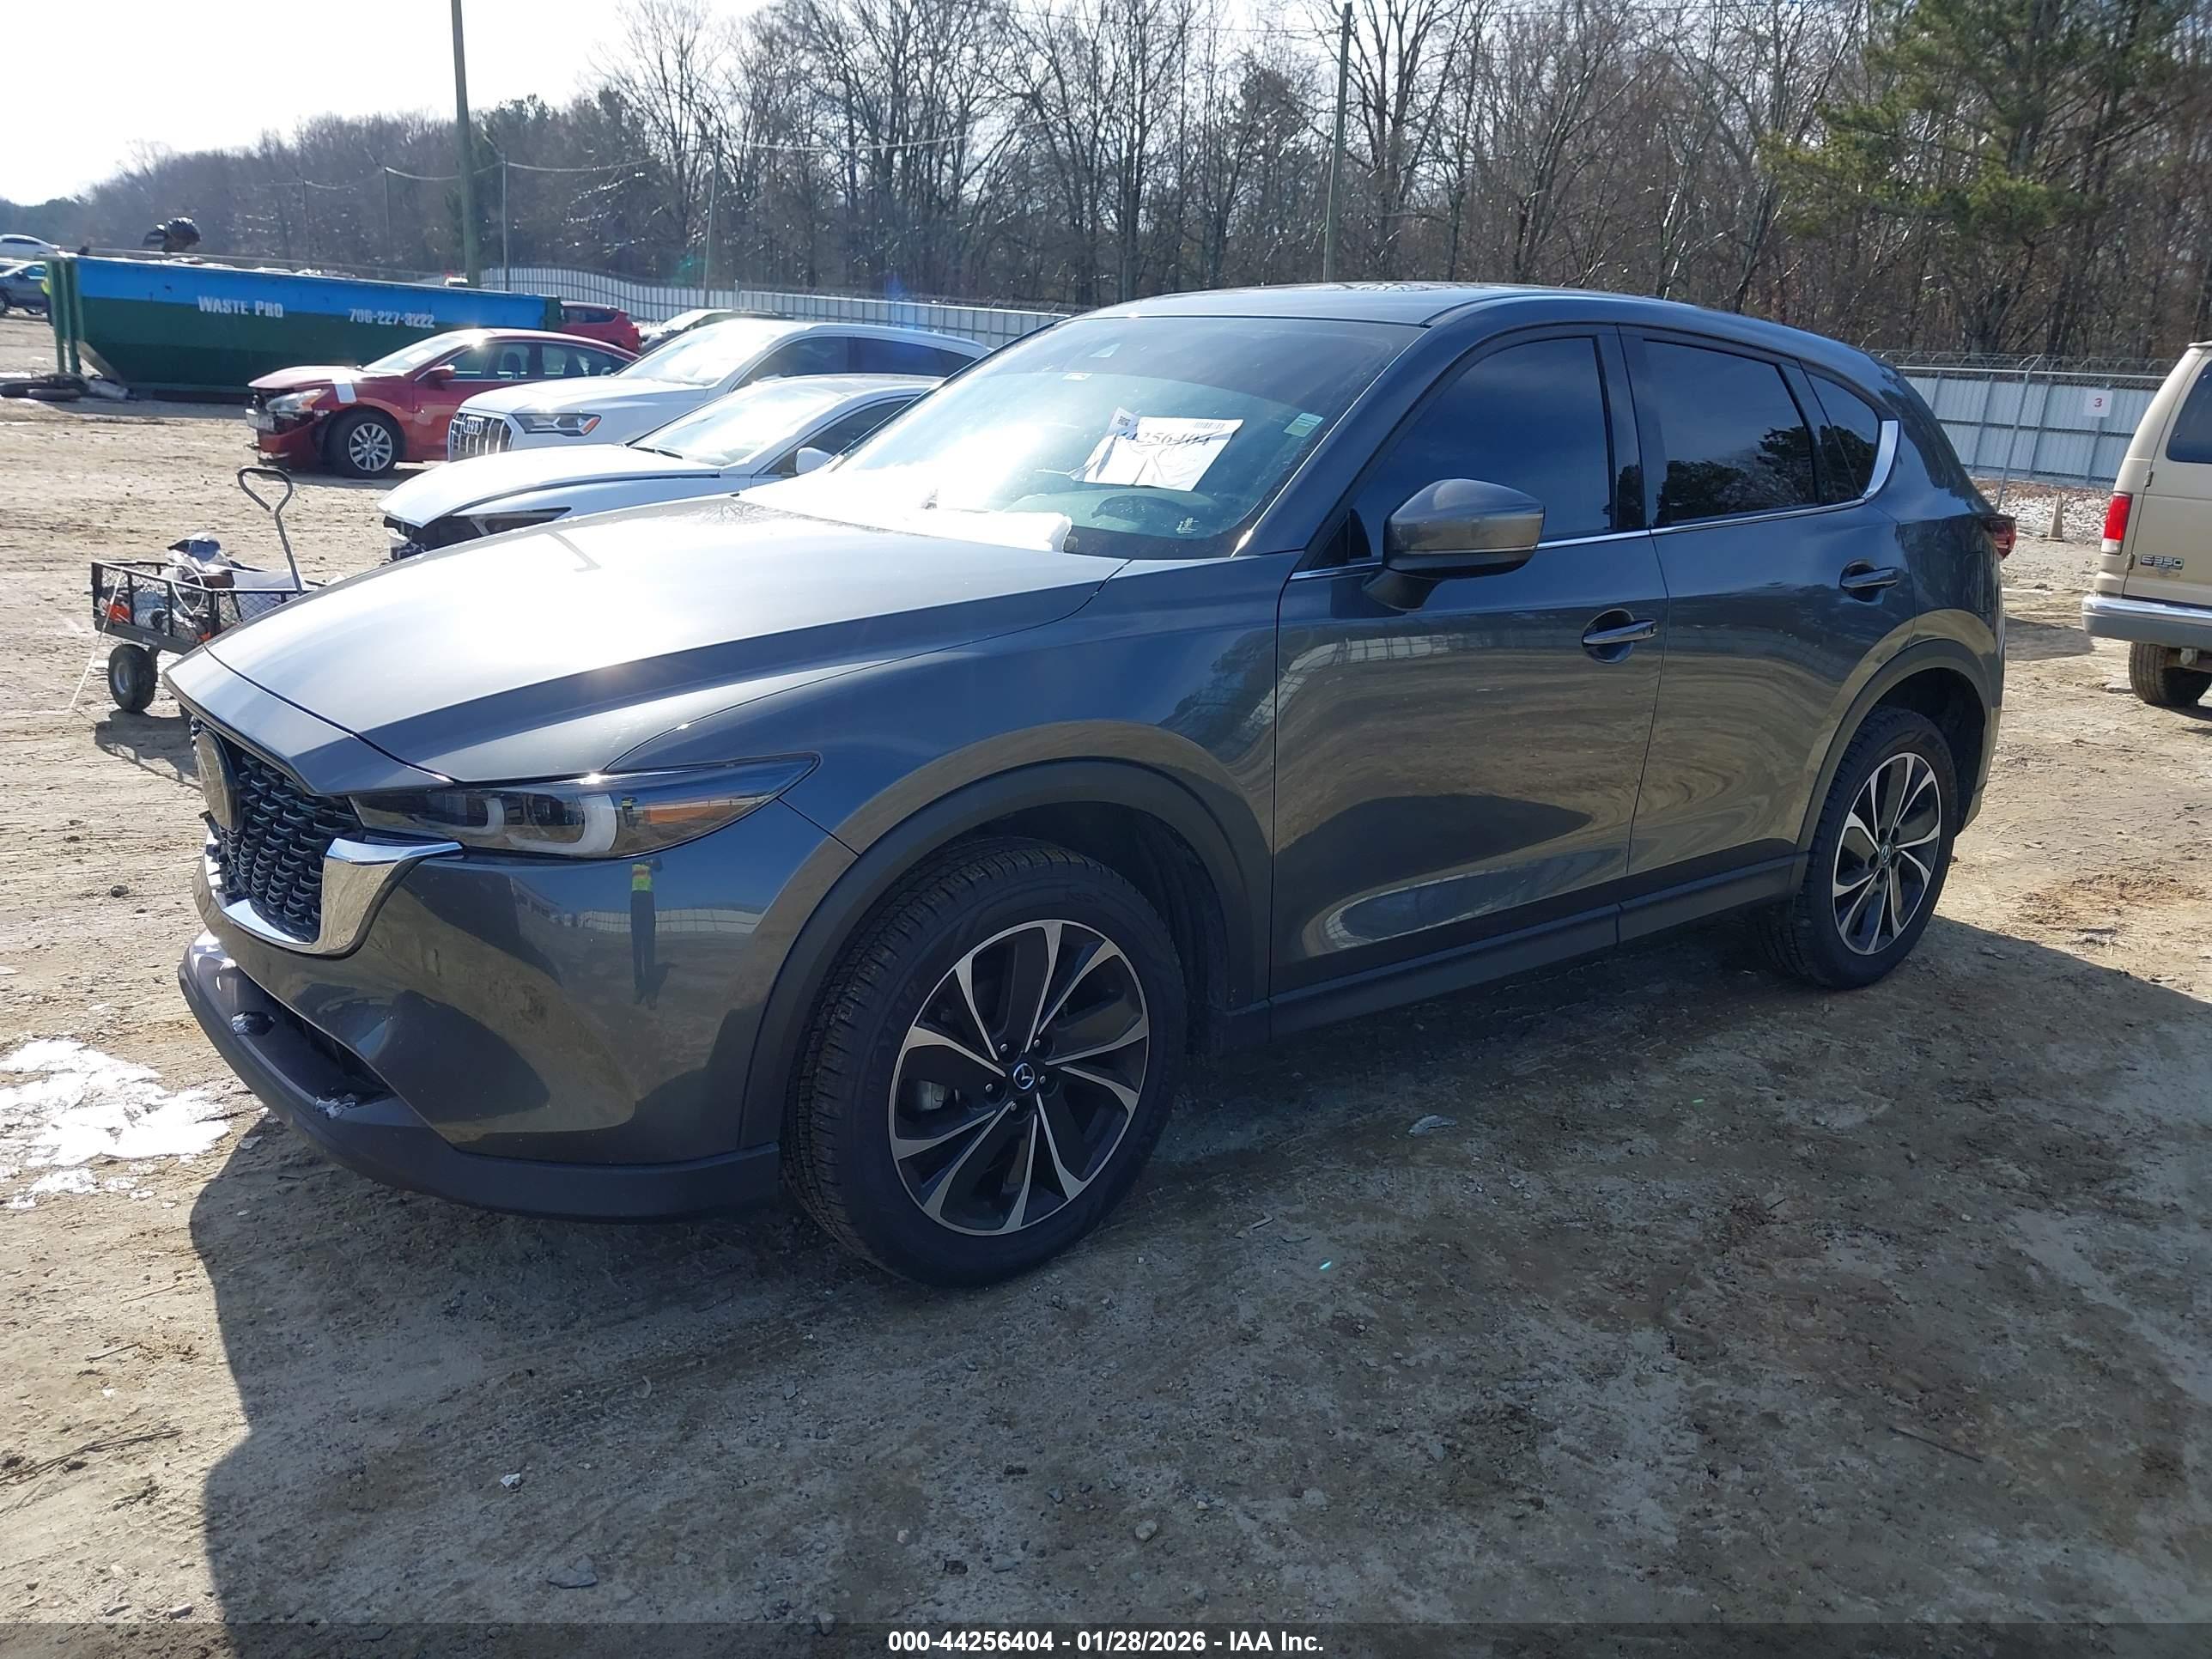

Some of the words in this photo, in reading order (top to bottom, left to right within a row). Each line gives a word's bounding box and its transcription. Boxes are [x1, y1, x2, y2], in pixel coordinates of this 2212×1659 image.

[198, 295, 249, 315] WASTE
[254, 300, 283, 318] PRO
[2094, 398, 2103, 408] 3
